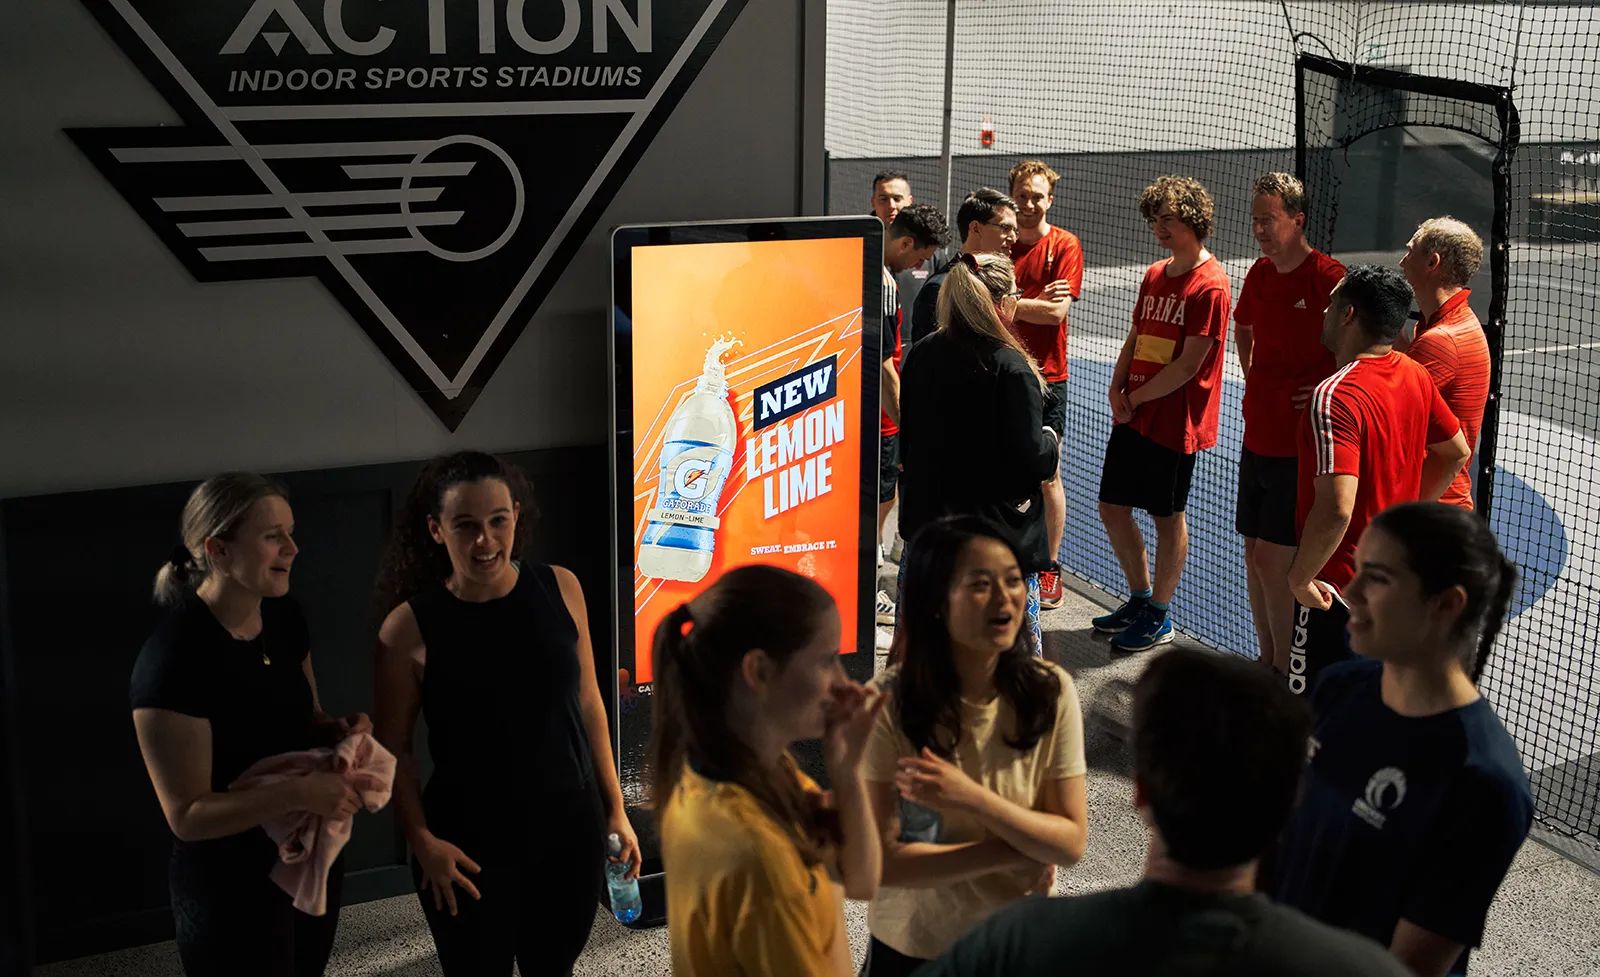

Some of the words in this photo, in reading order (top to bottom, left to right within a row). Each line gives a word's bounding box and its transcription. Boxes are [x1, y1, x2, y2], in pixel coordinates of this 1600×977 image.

[228, 68, 357, 92] INDOOR
[364, 66, 489, 90] SPORTS
[496, 65, 642, 88] STADIUMS
[760, 364, 833, 420] NEW
[746, 400, 845, 481] LEMON
[674, 458, 713, 500] G
[763, 452, 833, 520] LIME
[661, 512, 705, 524] LEMON-LIME
[662, 499, 712, 513] GATORADE
[750, 544, 782, 556] SWEAT.
[783, 541, 825, 554] EMBRACE
[826, 539, 837, 549] IT.
[1288, 606, 1310, 694] adida
